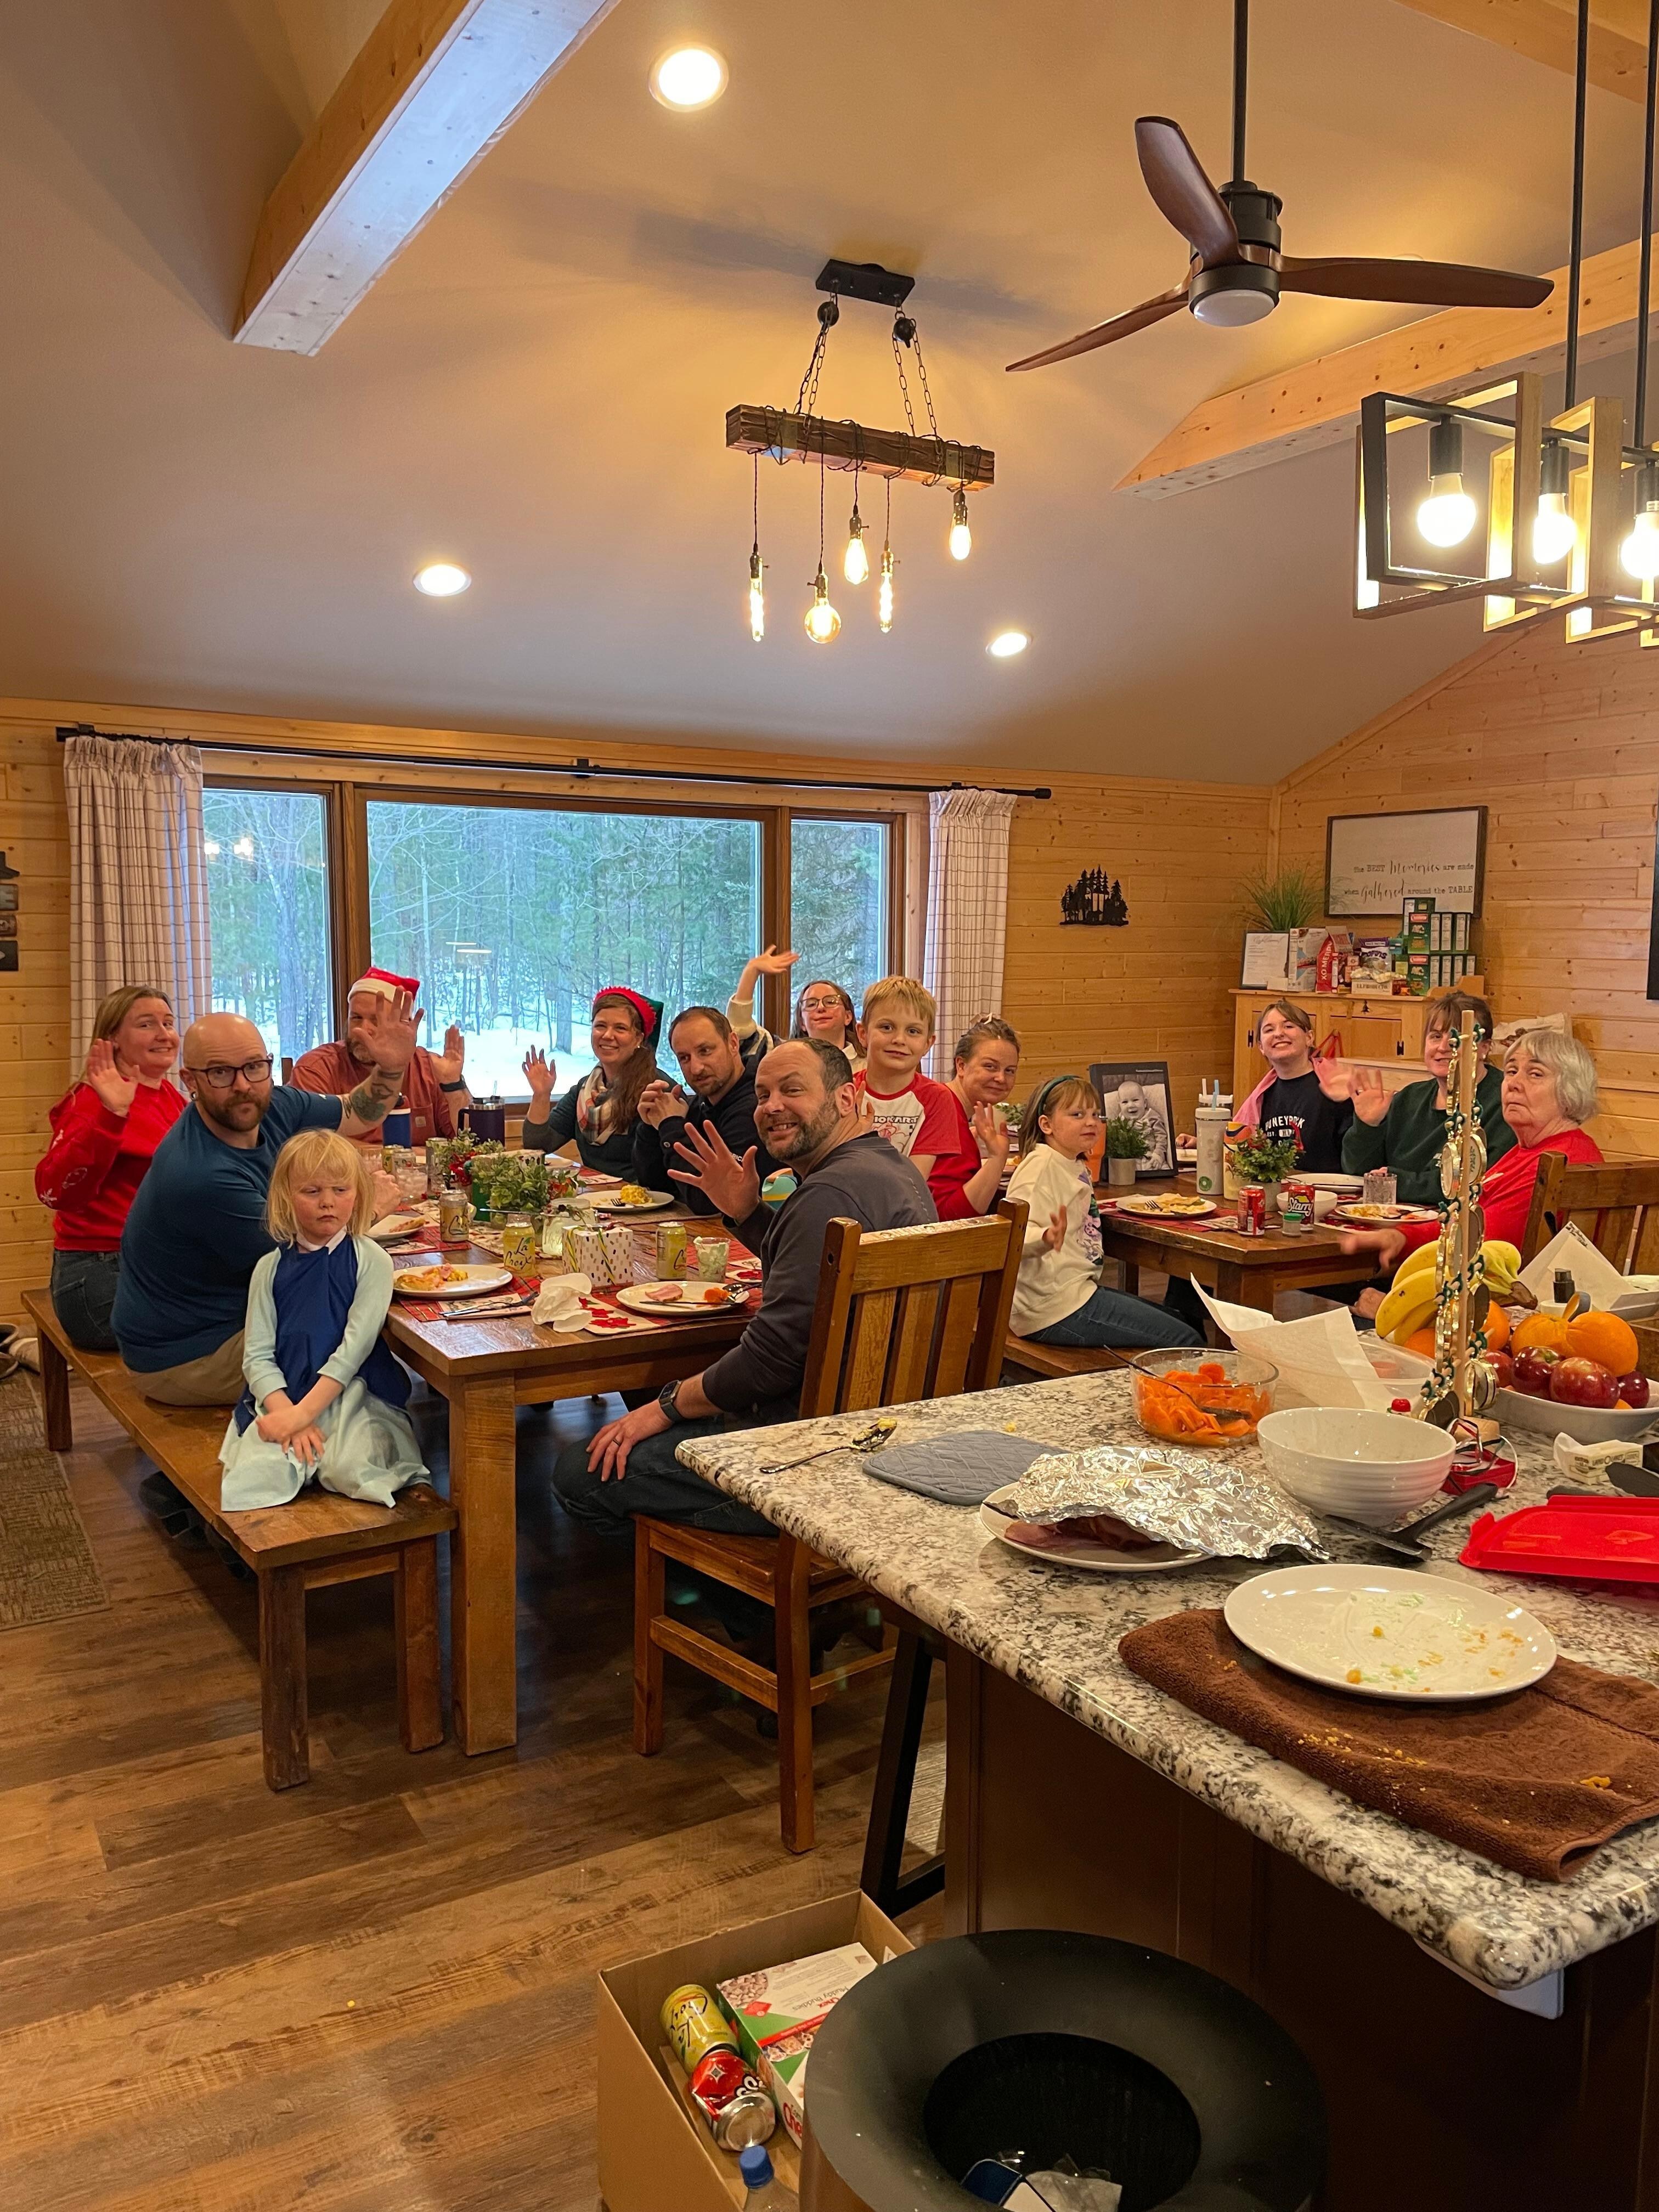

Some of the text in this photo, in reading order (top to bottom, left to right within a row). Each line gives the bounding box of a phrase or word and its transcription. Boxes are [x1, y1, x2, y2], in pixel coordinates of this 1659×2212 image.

[1367, 864, 1385, 872] BEST
[1448, 885, 1473, 894] TABLE
[1288, 1198, 1313, 1217] Starry
[514, 1237, 528, 1255] La
[504, 1251, 532, 1269] Croix
[792, 1995, 822, 2011] Buddies
[783, 2102, 803, 2139] Che
